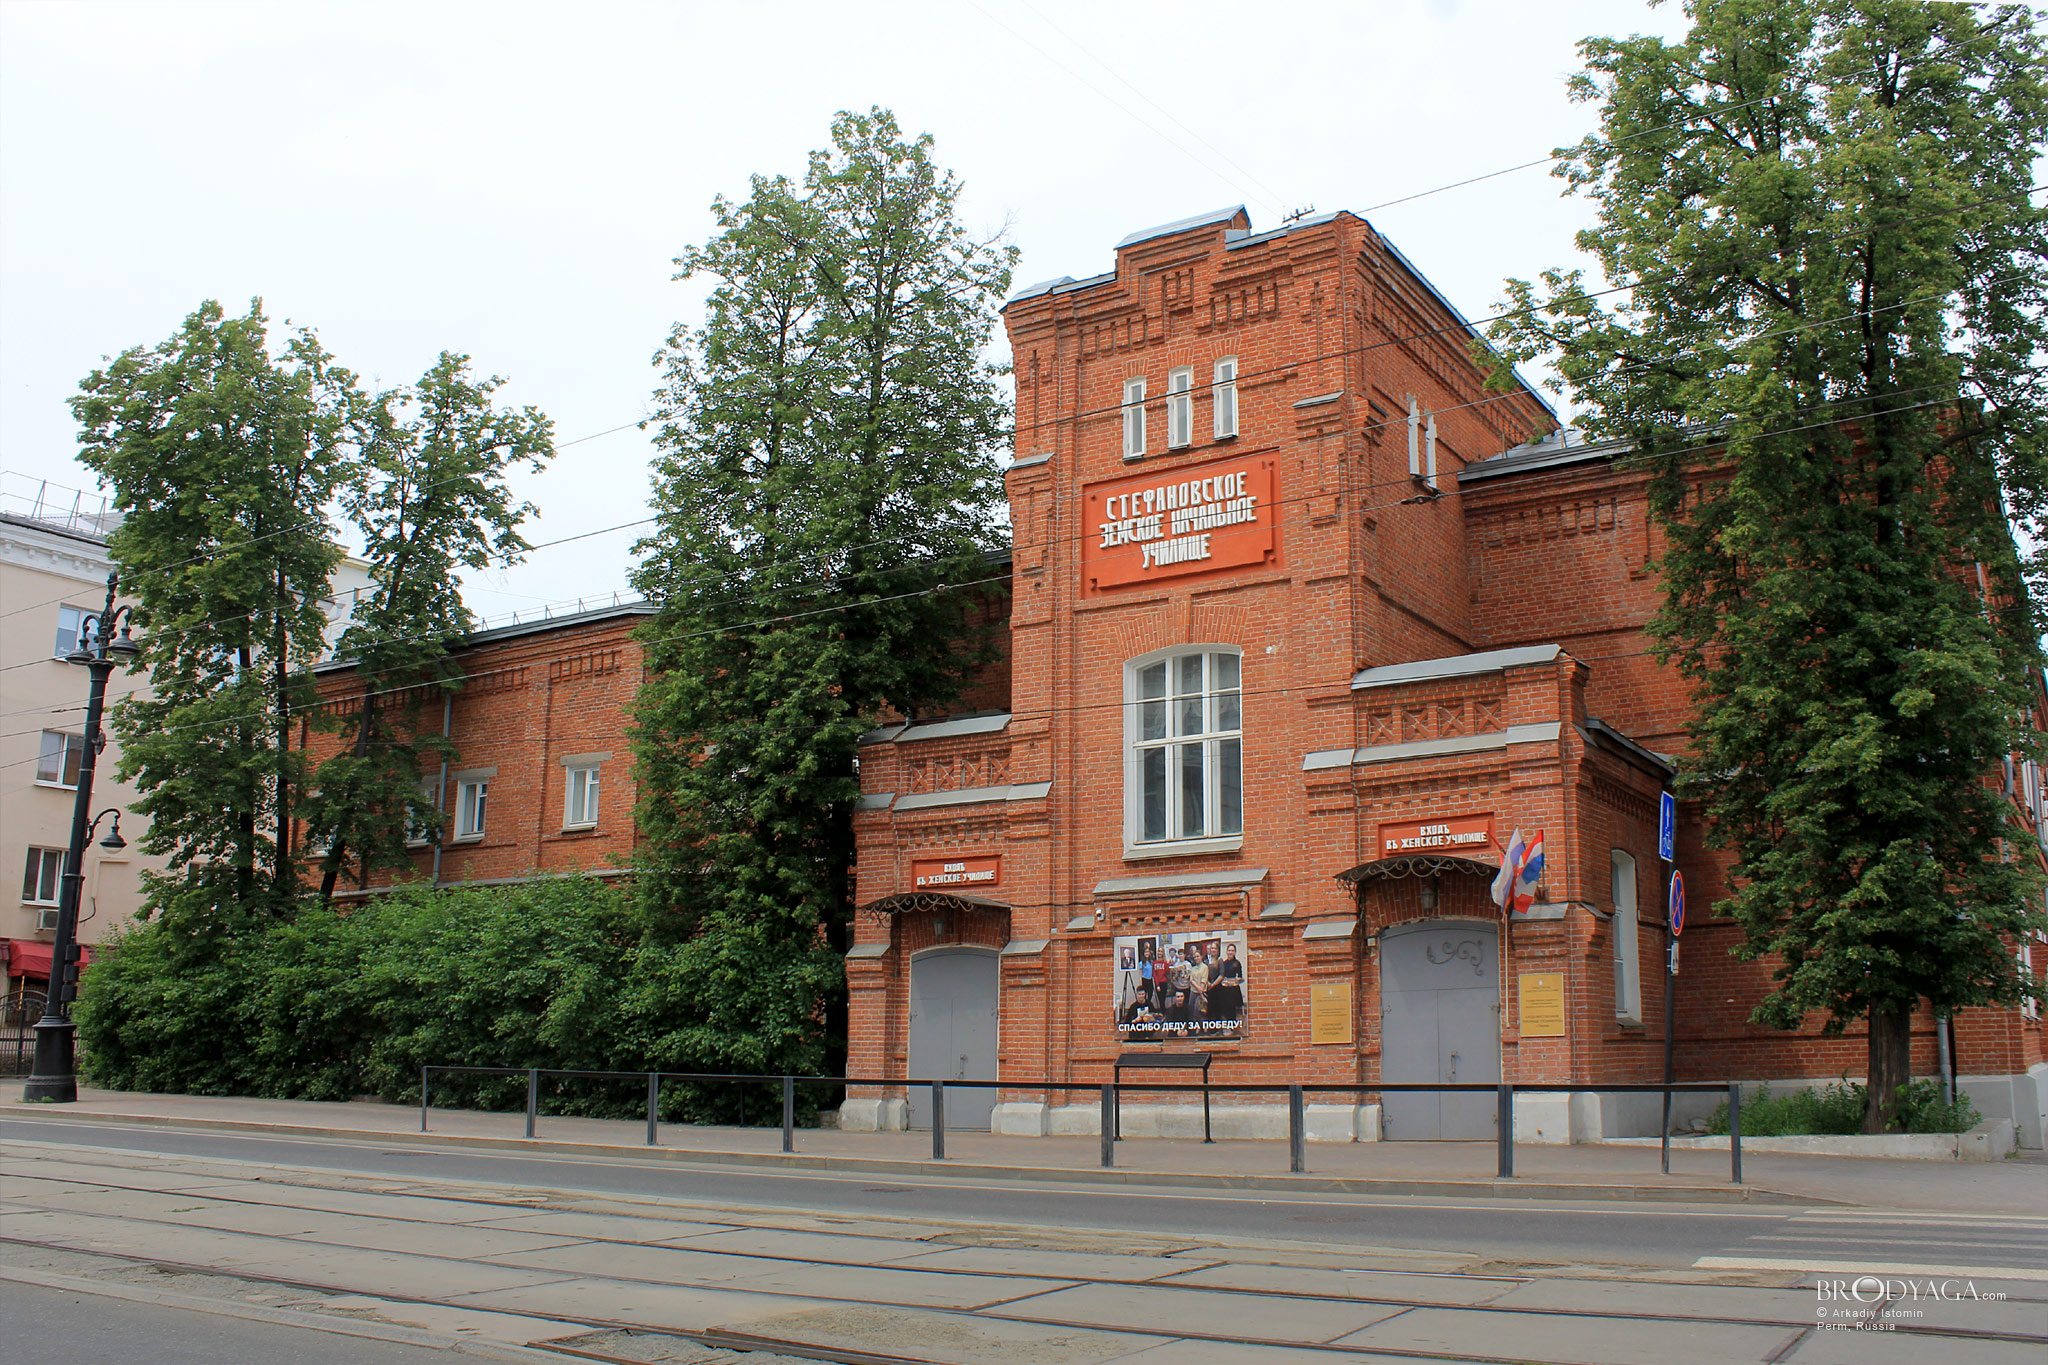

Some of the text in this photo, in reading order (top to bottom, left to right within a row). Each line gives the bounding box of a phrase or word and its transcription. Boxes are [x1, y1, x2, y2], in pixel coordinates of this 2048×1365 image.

[1106, 471, 1248, 520] СТЕФАНОВСКОЕ
[1099, 496, 1258, 548] ЗЕМСКОЕ НАЧАЛЬНОЕ
[1140, 533, 1212, 569] УЧИЛИЩЕ
[1420, 824, 1450, 836] ВХОДЪ
[1386, 832, 1488, 850] ВЪ ЖЕНСКОЕ УЧИЛИЩЕ
[928, 873, 961, 884] ЖЕНСКОЕ
[1118, 1020, 1243, 1032] СПАСИБО ДЕДУ ЗА ПОБЕДУ!
